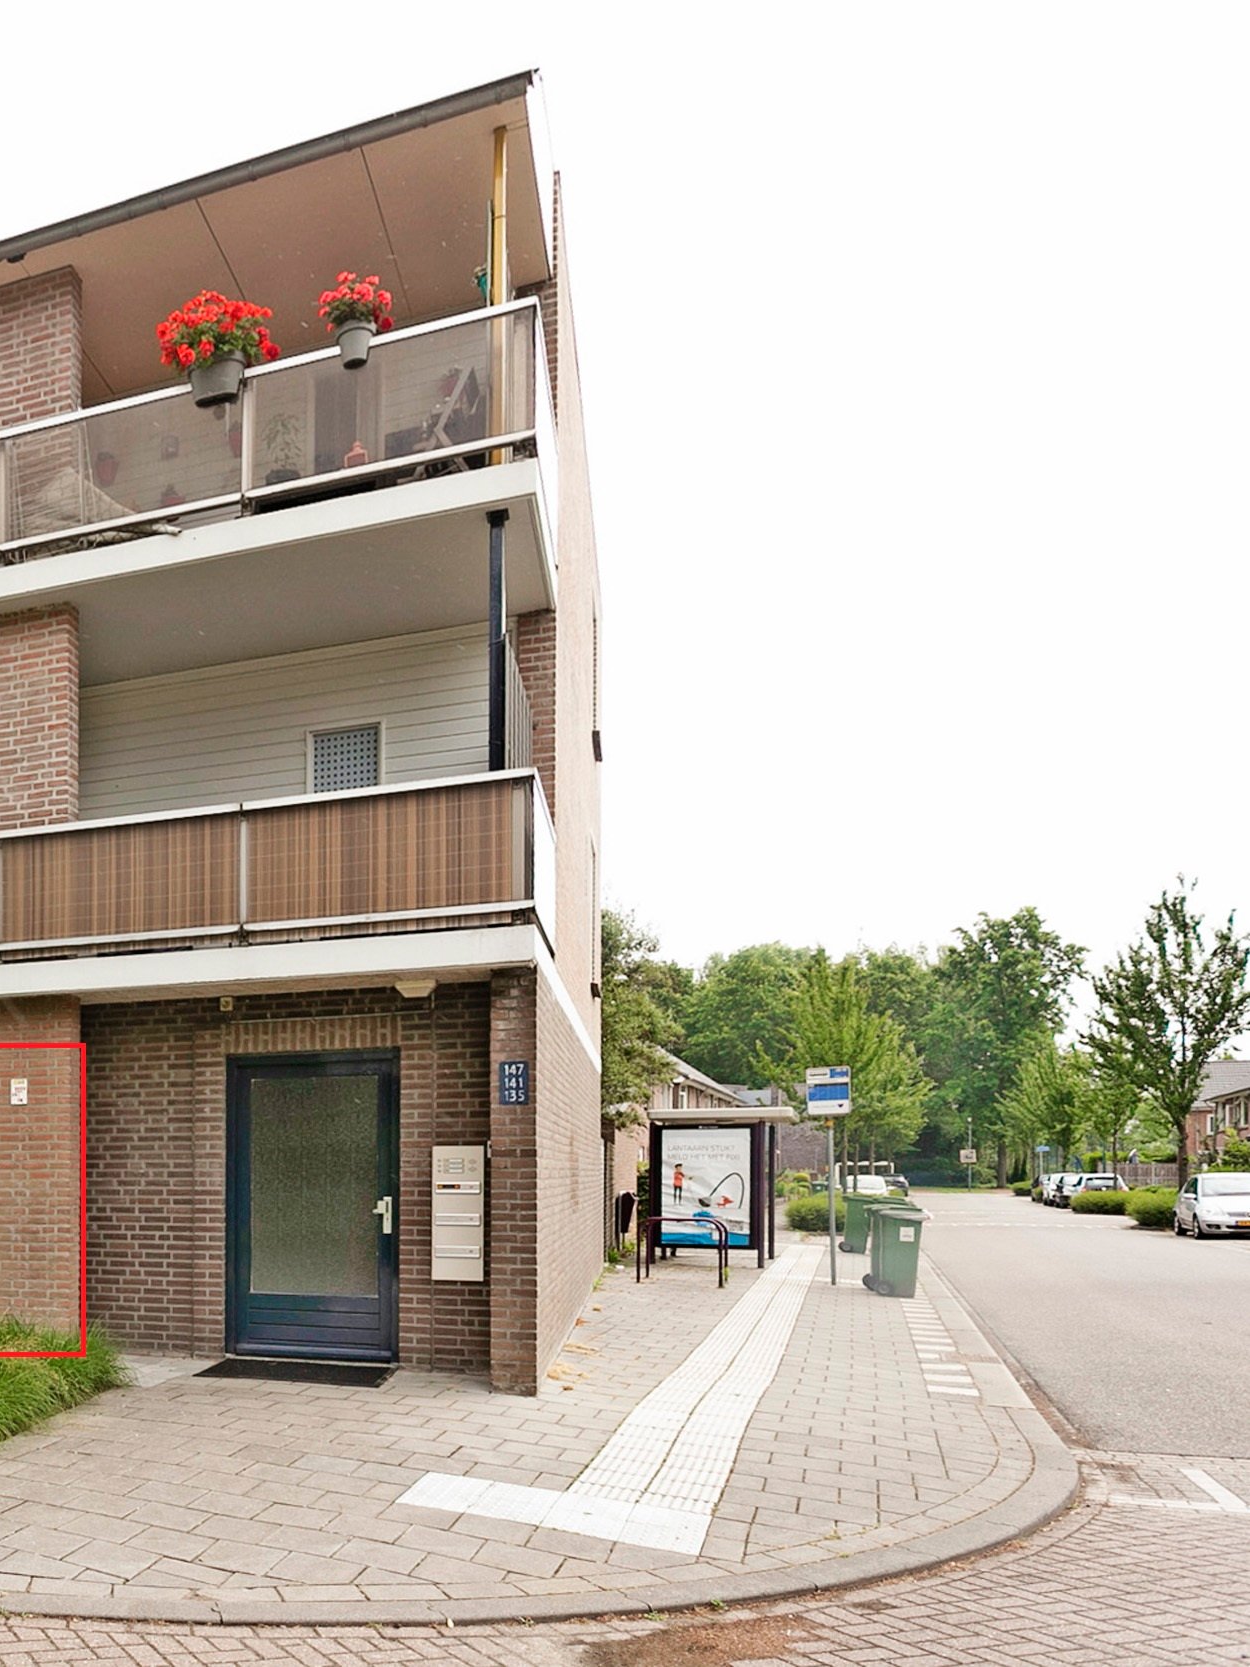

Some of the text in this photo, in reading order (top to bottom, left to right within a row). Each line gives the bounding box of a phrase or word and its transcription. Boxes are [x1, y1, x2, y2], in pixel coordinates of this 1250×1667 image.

[504, 1063, 524, 1076] 147
[504, 1077, 523, 1089] 141
[504, 1090, 525, 1102] 135
